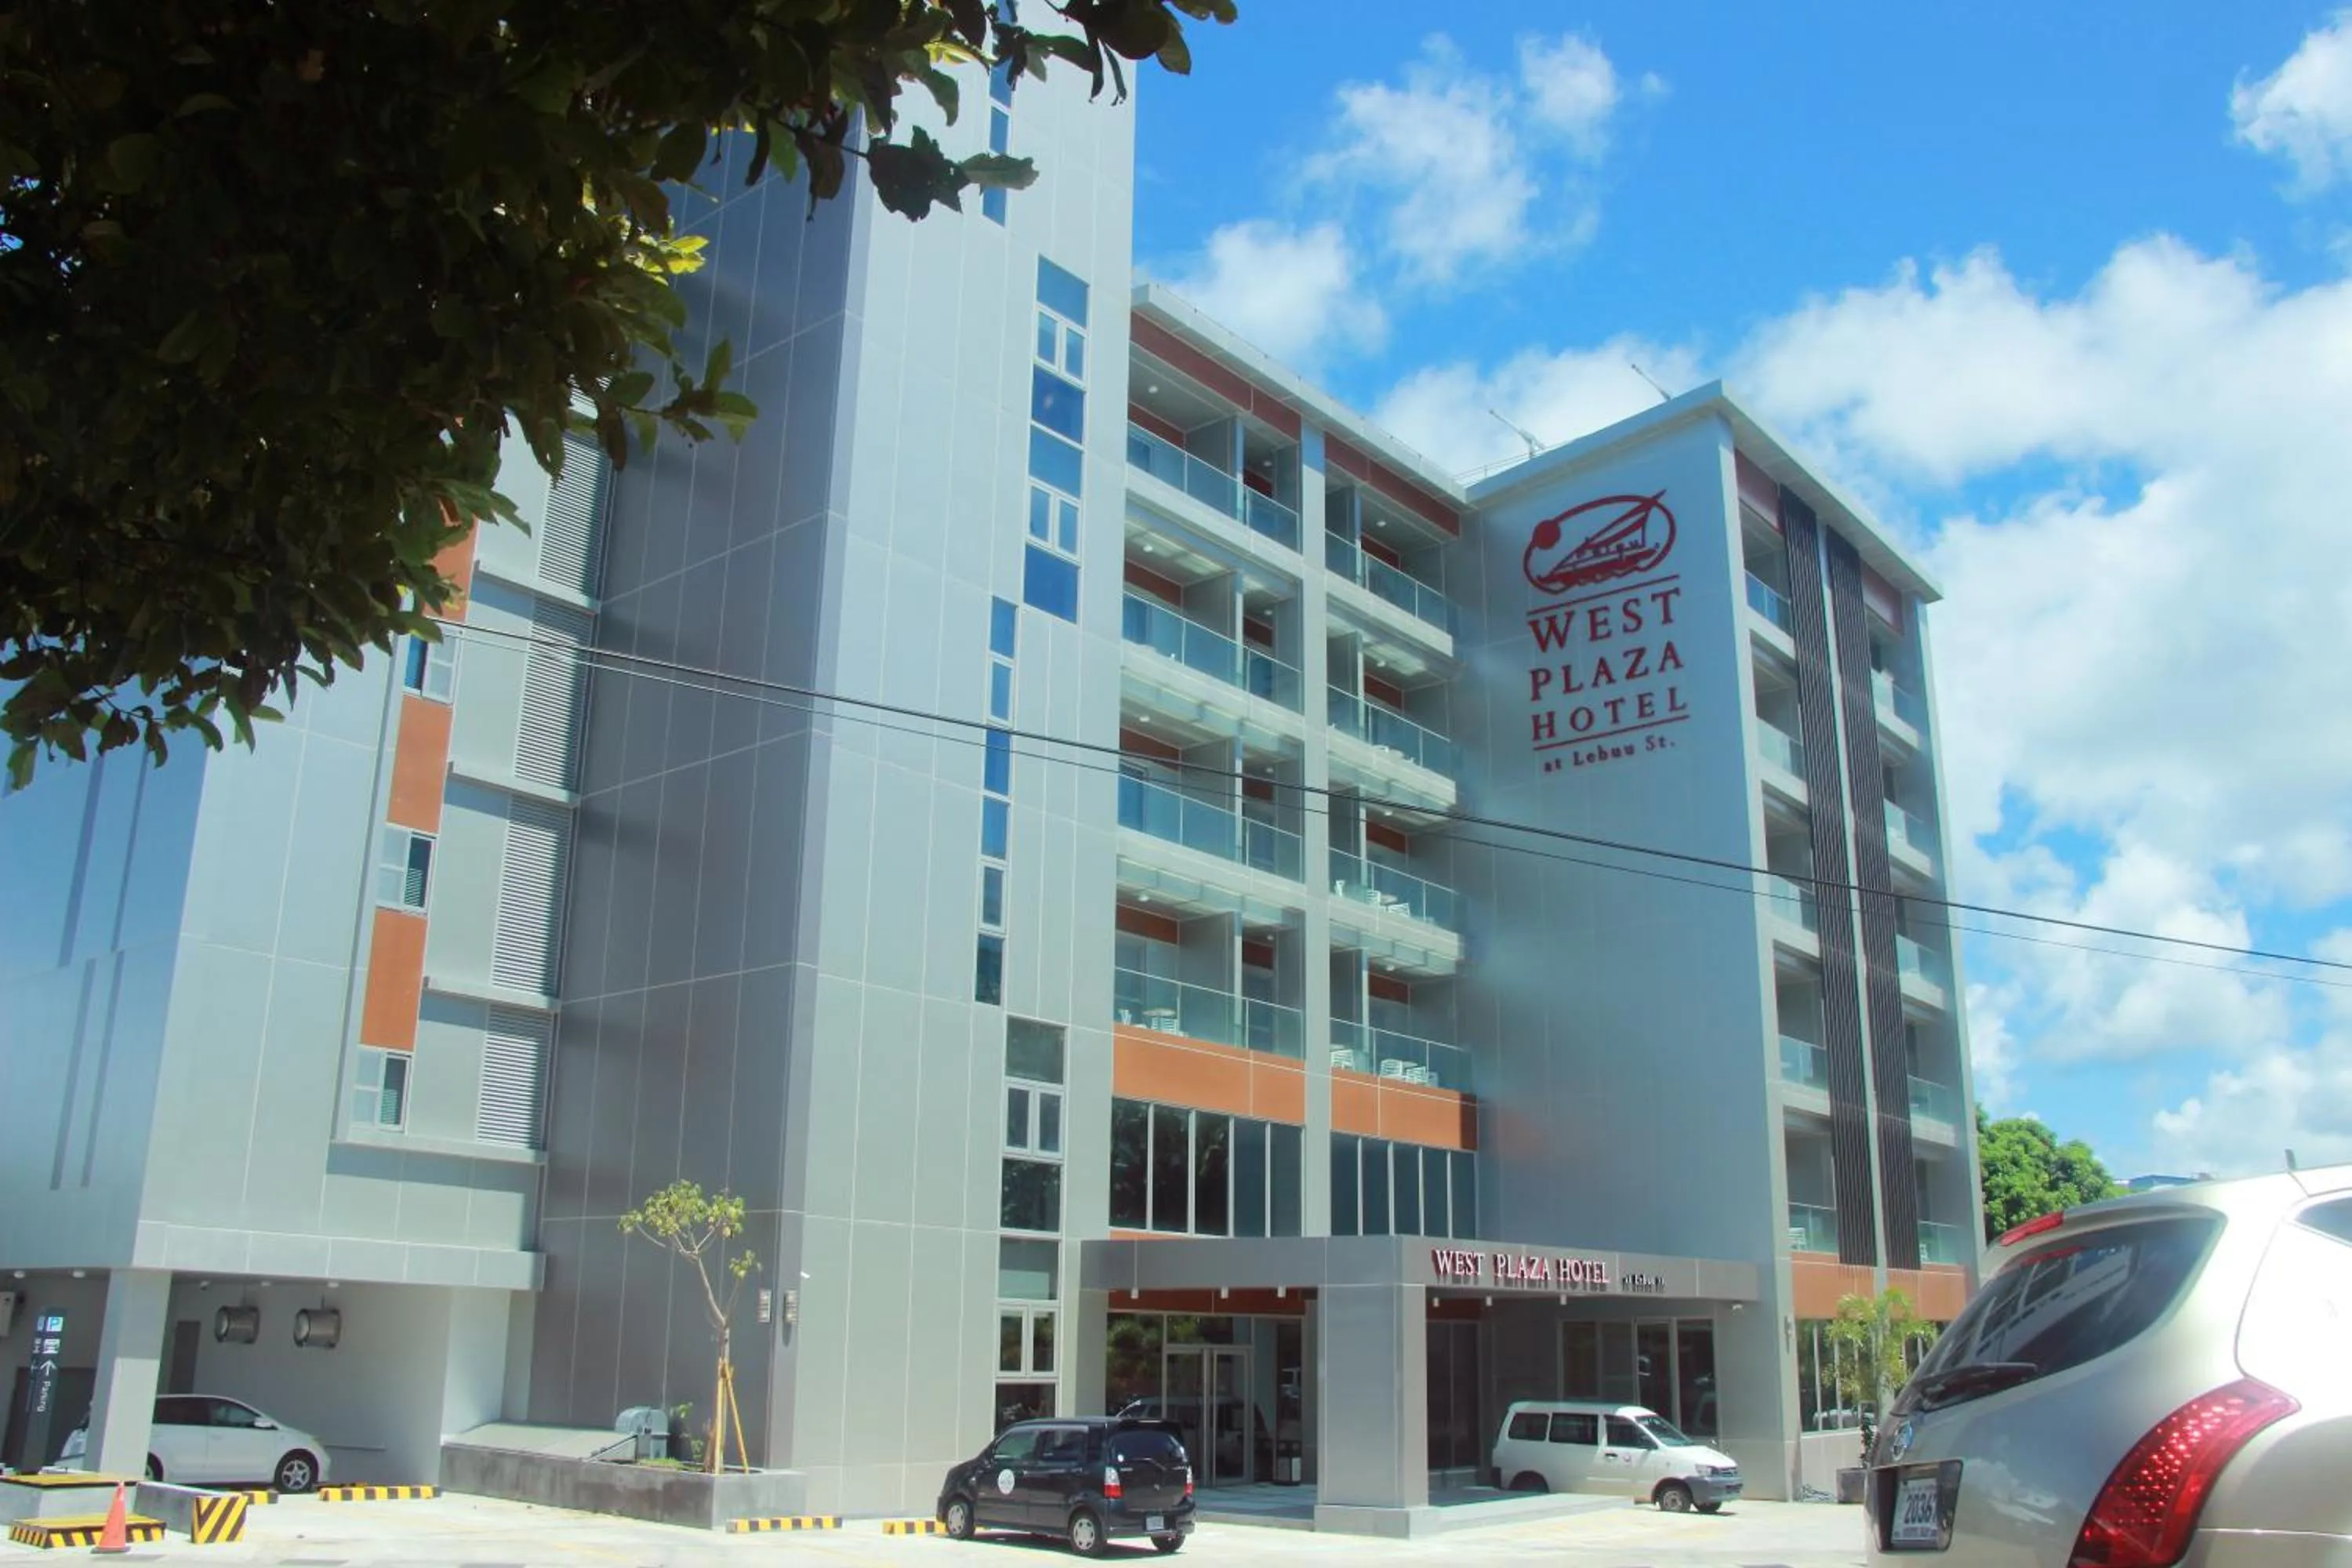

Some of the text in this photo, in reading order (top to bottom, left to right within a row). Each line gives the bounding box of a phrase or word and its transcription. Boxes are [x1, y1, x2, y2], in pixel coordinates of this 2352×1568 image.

[1529, 588, 1680, 652] WEST
[1530, 641, 1683, 701] PLAZA
[1532, 688, 1686, 741] HOTEL
[1544, 758, 1562, 772] at
[1646, 735, 1675, 751] St.
[1432, 1250, 1484, 1276] WEST
[1492, 1254, 1550, 1281] PLAZA
[1556, 1258, 1609, 1283] HOTEL
